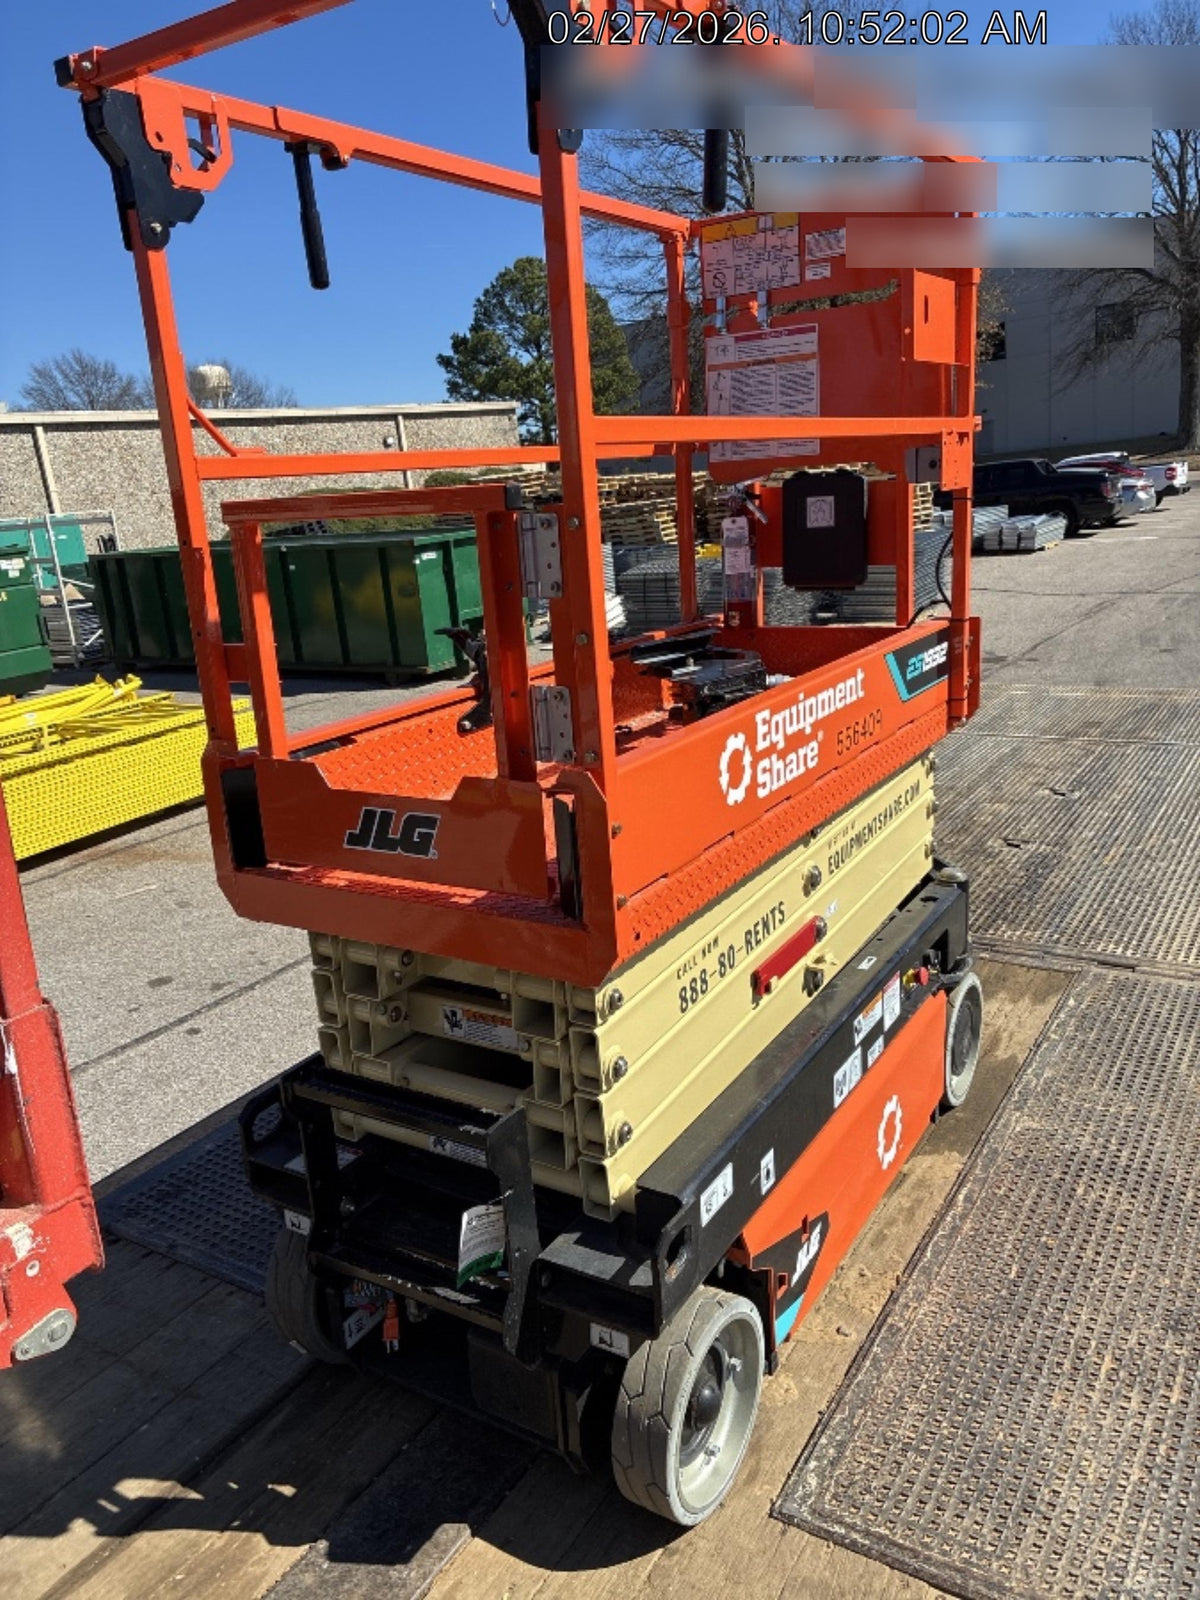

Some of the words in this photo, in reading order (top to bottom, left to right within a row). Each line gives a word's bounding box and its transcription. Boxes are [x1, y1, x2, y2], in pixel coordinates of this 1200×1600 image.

[755, 668, 865, 752] Equipment
[343, 806, 441, 859] JLG
[828, 779, 920, 874] EQUIPMENTSHARE.COM
[679, 900, 785, 1014] 888-80-RENTS
